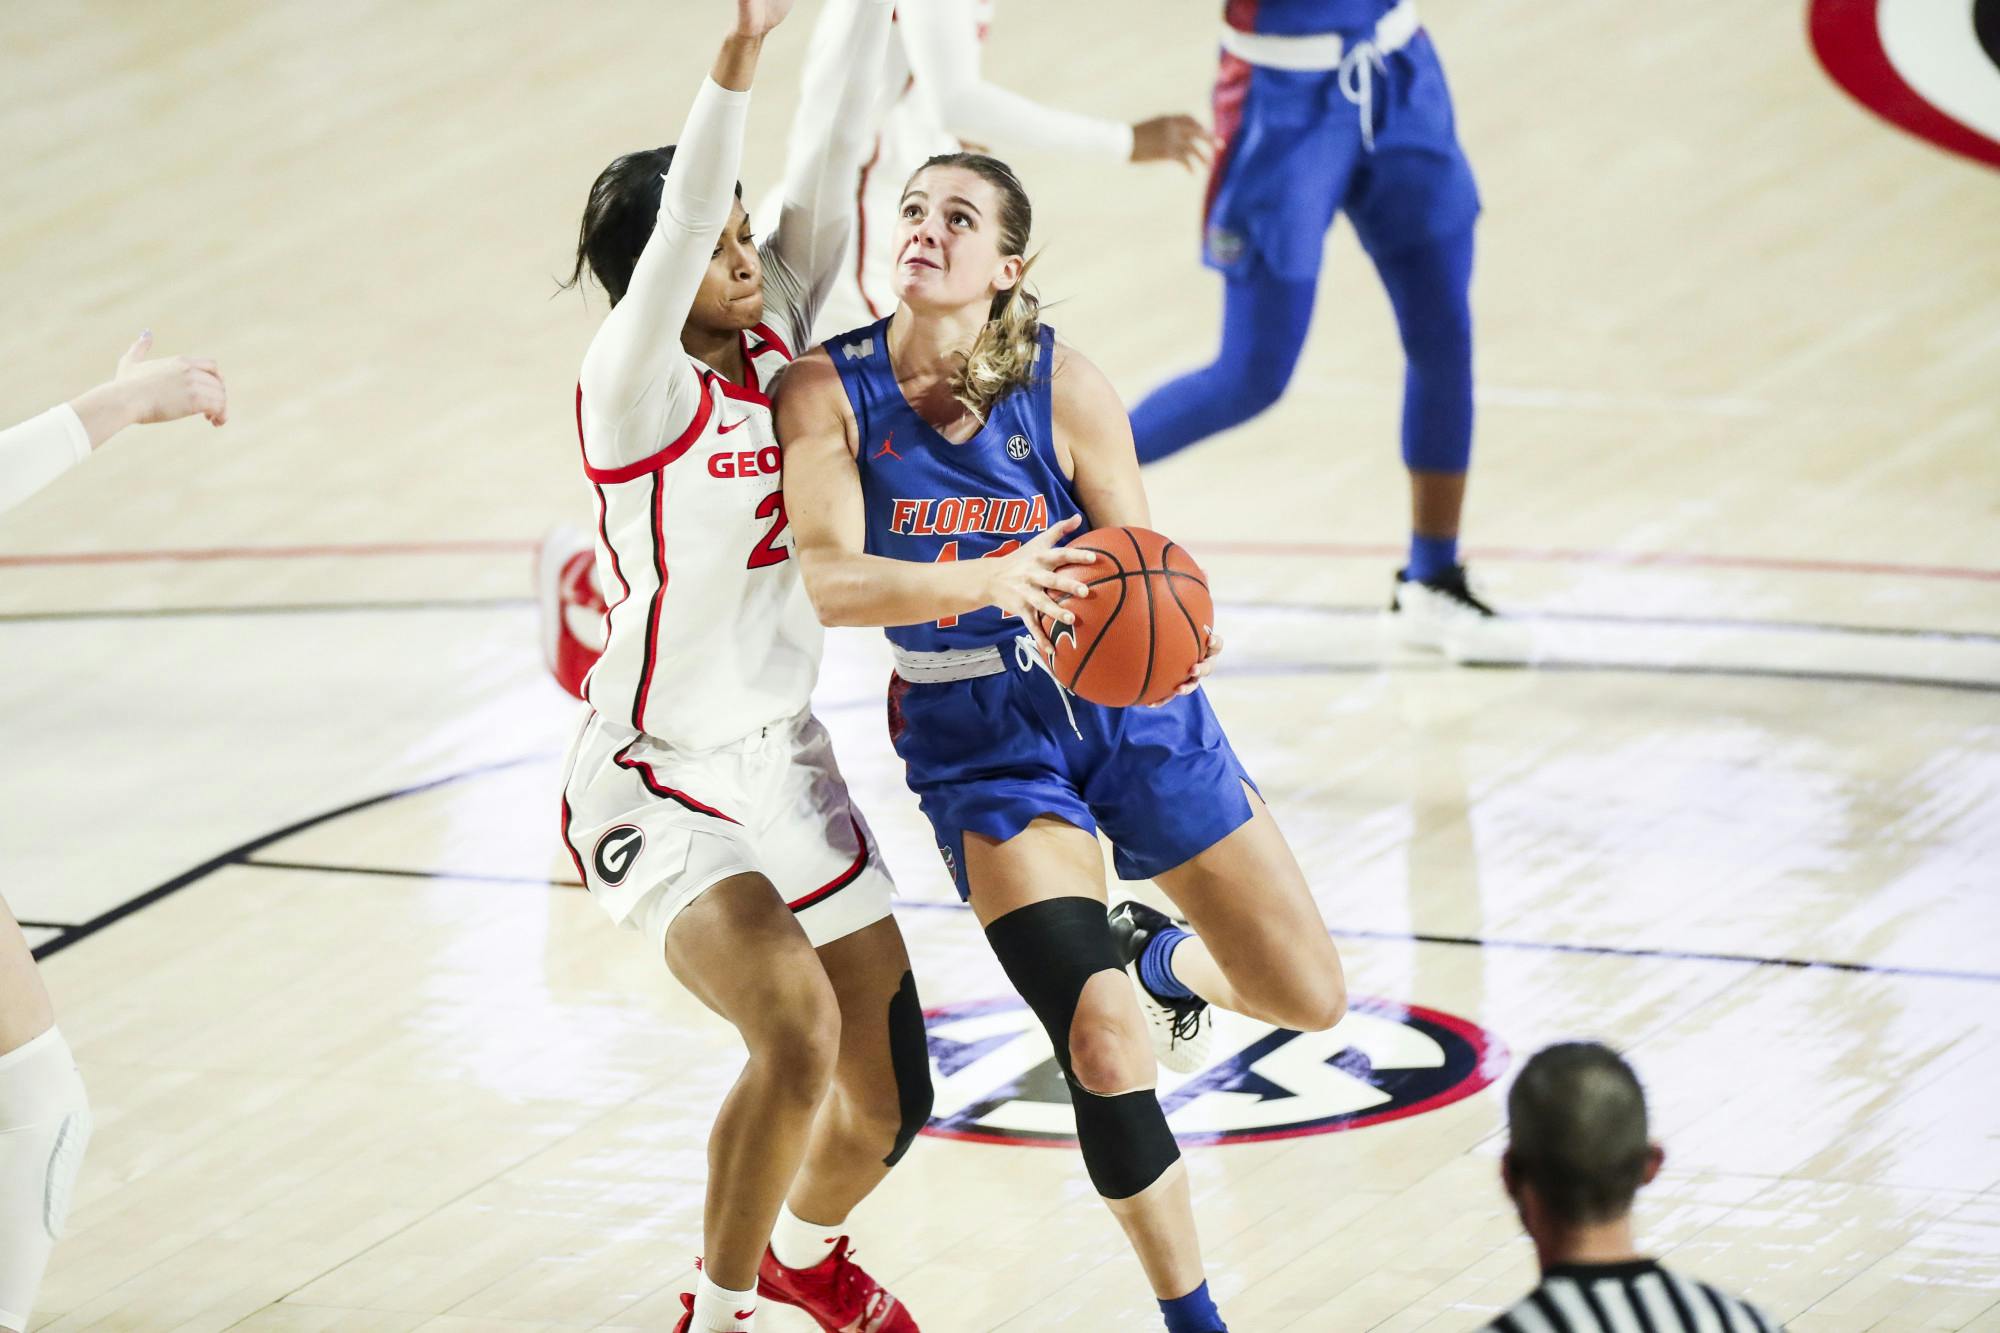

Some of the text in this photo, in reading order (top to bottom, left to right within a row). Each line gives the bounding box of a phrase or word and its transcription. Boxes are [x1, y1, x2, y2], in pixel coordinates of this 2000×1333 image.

[707, 446, 782, 479] GEO
[1008, 436, 1029, 458] SEC
[746, 490, 796, 570] 2
[889, 494, 1048, 536] FLORIDA
[594, 826, 644, 885] G
